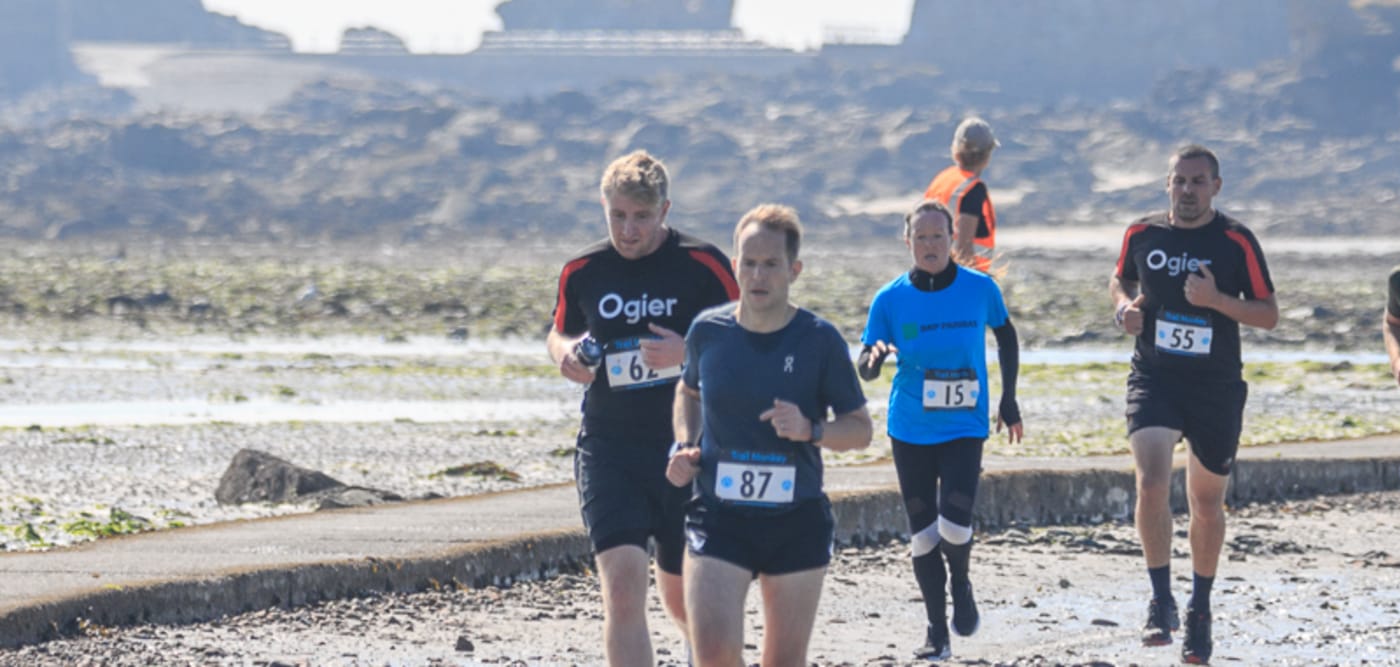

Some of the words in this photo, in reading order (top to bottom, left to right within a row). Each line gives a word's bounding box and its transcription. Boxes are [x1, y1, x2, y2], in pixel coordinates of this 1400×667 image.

[598, 293, 678, 324] Ogier
[1170, 328, 1195, 349] 55
[945, 384, 964, 406] 15
[740, 470, 773, 499] 87
